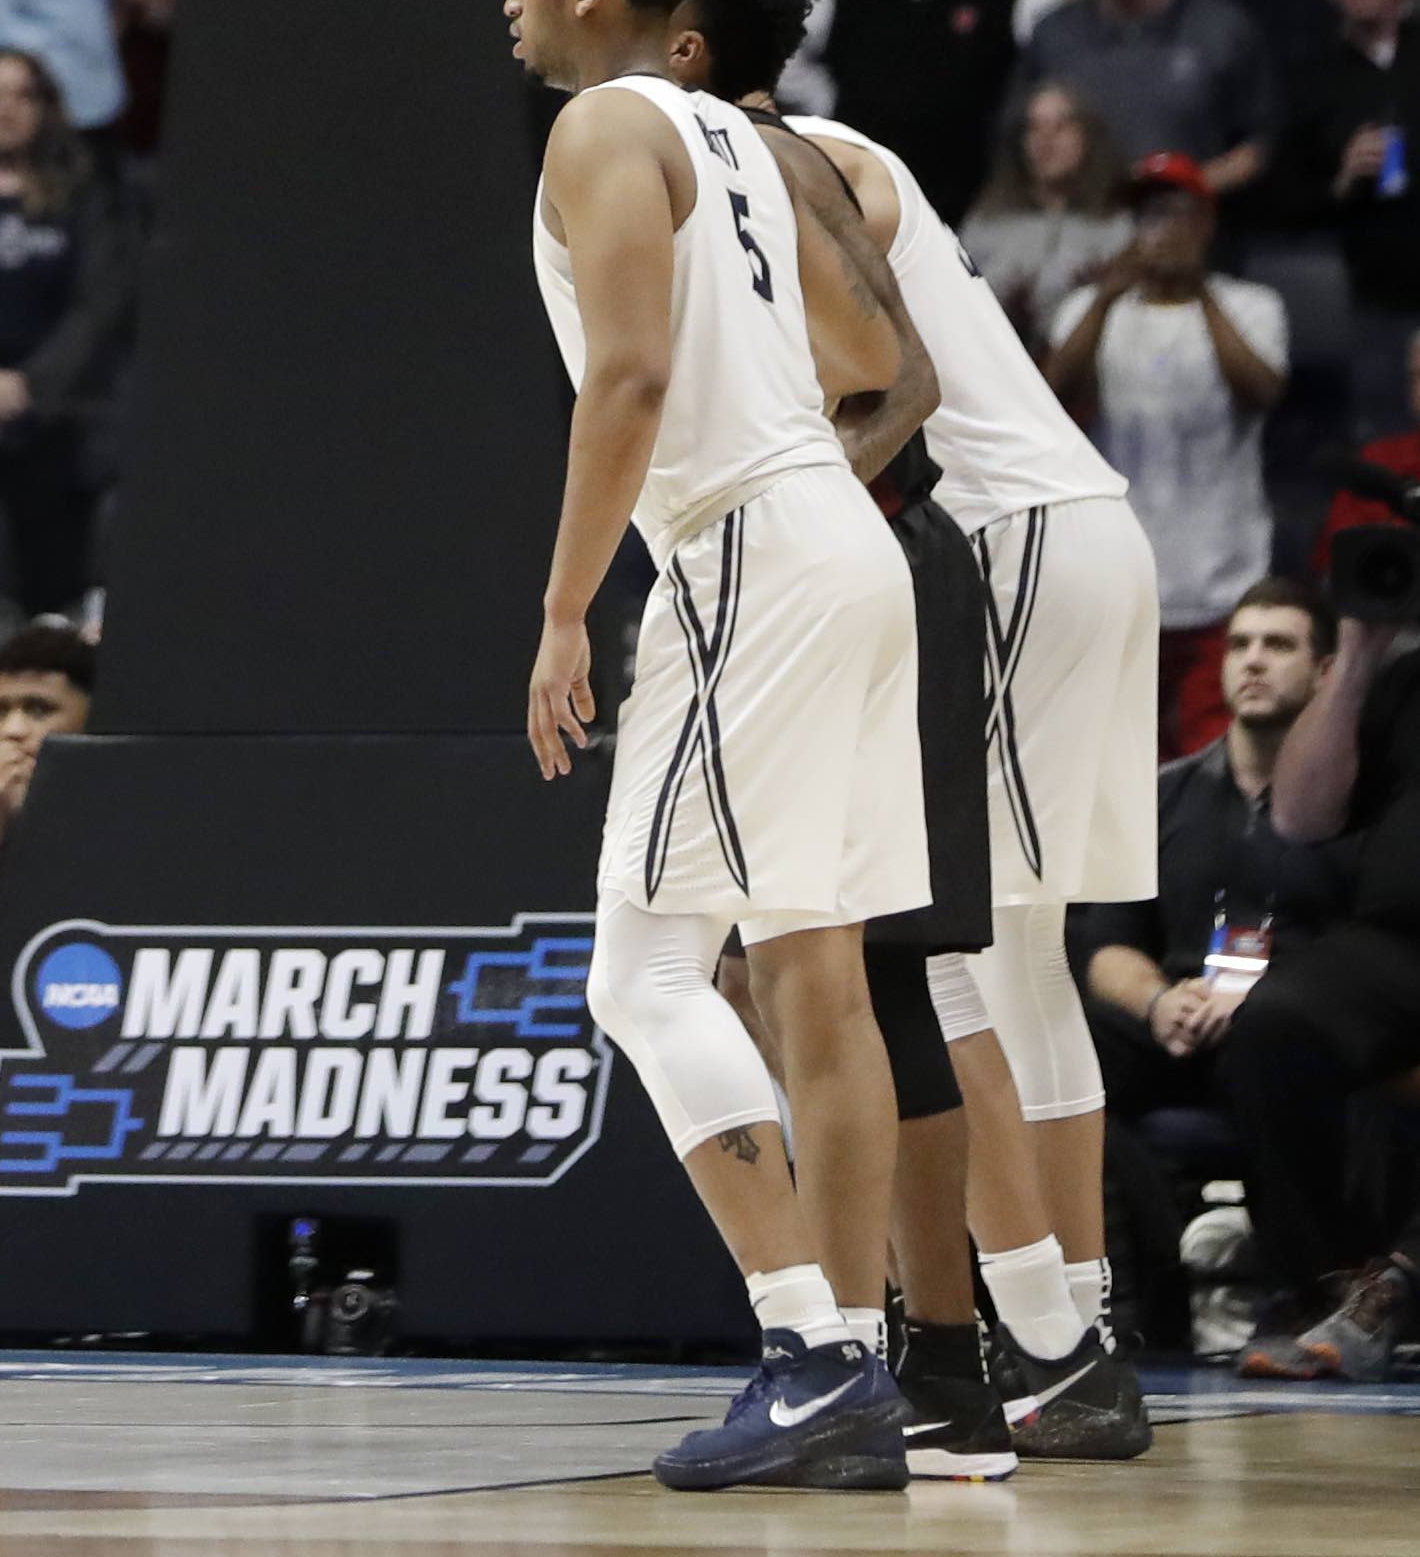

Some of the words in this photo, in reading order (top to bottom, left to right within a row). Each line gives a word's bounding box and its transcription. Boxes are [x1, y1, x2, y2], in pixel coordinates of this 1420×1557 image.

[727, 188, 775, 304] 5
[120, 947, 447, 1041] MARCH
[156, 1045, 594, 1140] MADNESS
